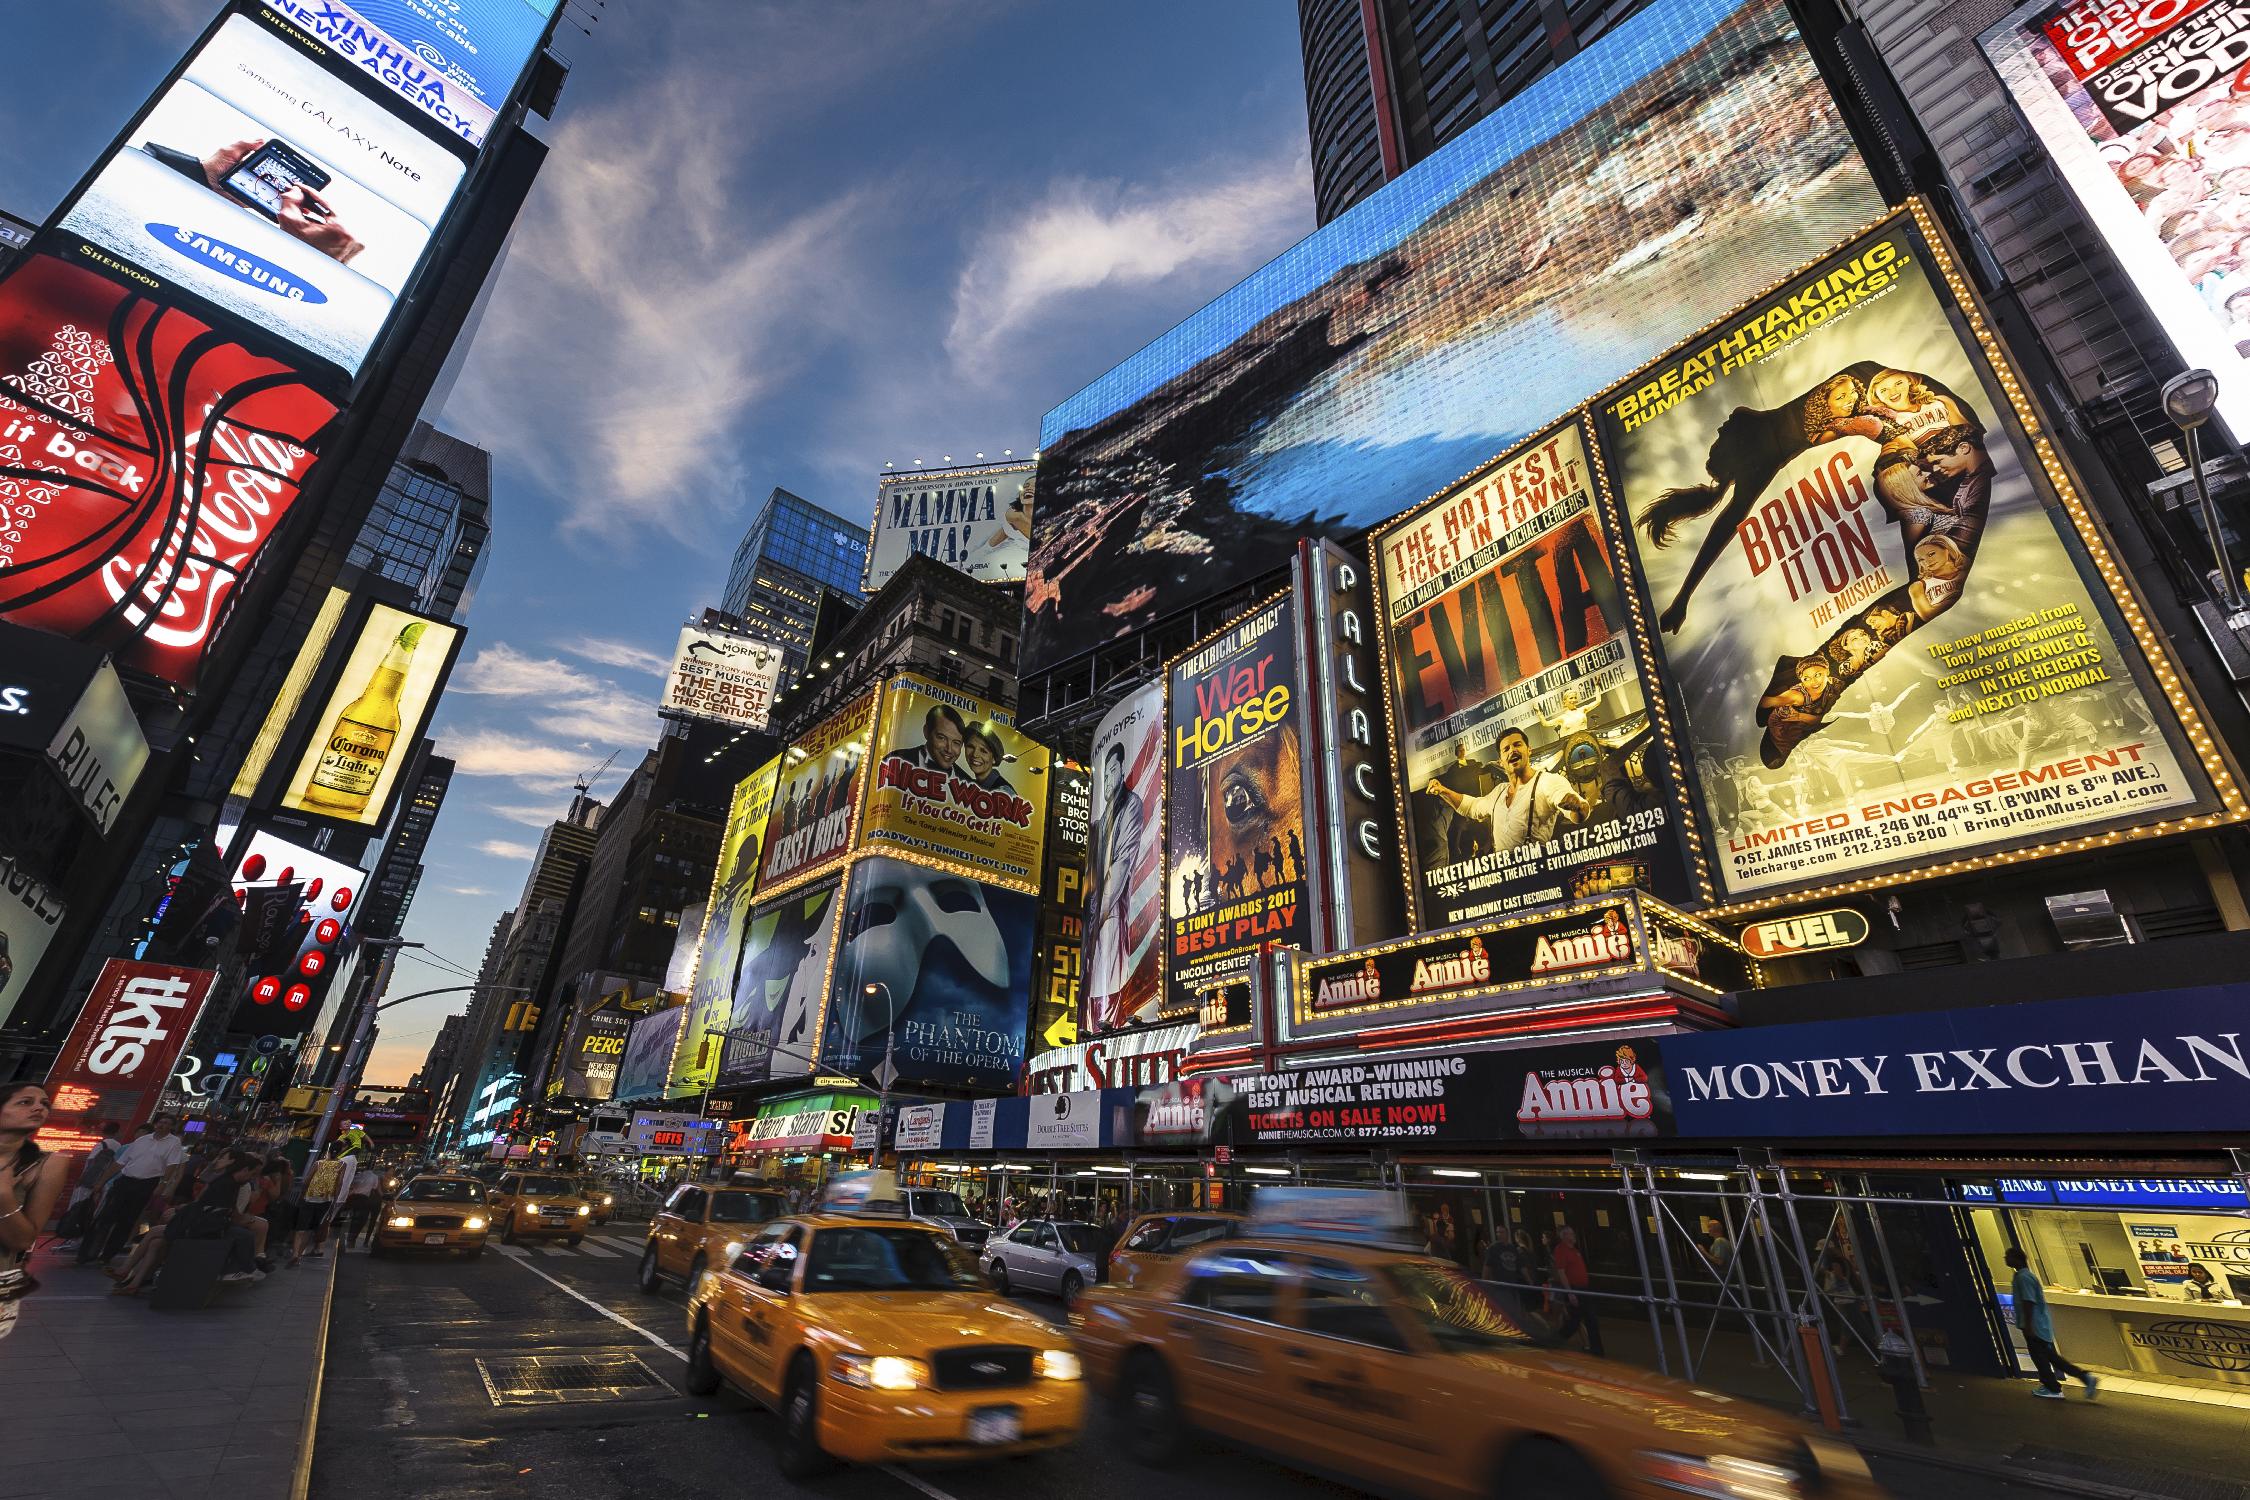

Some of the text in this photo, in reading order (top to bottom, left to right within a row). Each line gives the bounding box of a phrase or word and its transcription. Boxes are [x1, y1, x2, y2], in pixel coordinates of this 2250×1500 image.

[260, 9, 326, 56] SHERWOOD
[314, 1, 446, 103] XINHUA
[435, 20, 478, 55] Cable
[270, 0, 472, 134] NEWS AGENCY
[2095, 28, 2188, 90] DESERVE
[237, 63, 422, 183] Samsung GALAXY Note
[79, 245, 160, 289] SHERWOOD
[174, 227, 305, 302] SAMSUNG
[1758, 284, 1897, 366] THE NEW YORK TIMES
[1624, 372, 1715, 433] HUMAN
[46, 432, 144, 493] back
[886, 486, 996, 529] MAMMA
[893, 482, 948, 494] BENNY ANDERSSON
[1442, 438, 1560, 540] HOTTEST
[1737, 450, 1869, 578] BRING
[906, 525, 972, 565] MIA!
[1396, 540, 1461, 593] TICKET
[1393, 572, 1445, 618] RICKY MARTIN
[1809, 567, 1893, 629] THE MUSICAL
[1393, 511, 1622, 731] EVITA
[1928, 602, 2078, 658] The new musical from
[680, 662, 769, 690] BEST MUSICAL
[682, 656, 740, 674] WINNER TONY
[1937, 637, 2074, 689] creators AVENUE
[1942, 652, 1974, 669] Tony
[2001, 648, 2102, 689] THE HEIGHTS
[672, 694, 700, 708] THIS
[673, 685, 740, 708] MUSICAL
[719, 681, 767, 702] BEST
[924, 684, 978, 714] BRODERICK
[1195, 652, 1274, 721] War
[1433, 641, 1623, 742] TIM RICE ANDREW LLOYD WEBBER
[1949, 666, 2111, 724] and NEXT NORMAL
[820, 694, 874, 735] CROWD
[1113, 704, 1145, 737] GYPSY.
[1176, 684, 1290, 769] Horse
[1335, 561, 1382, 861] PALACE
[330, 735, 385, 760] Corona
[333, 755, 368, 774] Light
[877, 757, 1035, 830] NICE WORK
[901, 793, 915, 811] If
[916, 799, 940, 819] You
[941, 805, 966, 824] Can
[967, 814, 989, 831] Get
[990, 820, 1003, 837] It
[1729, 812, 1850, 853] LIMITED
[1862, 743, 2145, 822] ENGAGEMENT
[766, 822, 816, 880] JERSEY
[812, 804, 852, 860] BOYS
[1425, 807, 1666, 888] TICKETMASTER.COM 877-250-2929
[1736, 849, 1838, 880] Telecharge.com
[1843, 825, 1947, 857] 212.239.6200
[1964, 781, 2168, 834] BringItOnMusical.com
[1747, 799, 1998, 865] ST. JAMES 246 ST.
[930, 841, 1029, 877] FUNNIEST LOVE STORY
[1467, 830, 1658, 892] MARQUIS THEATRE EVITAONBROADWAY.COM
[1176, 888, 1296, 935] 5 TONY 2011
[1448, 886, 1563, 923] NEW BROADWAY CAST RECORDING
[1176, 923, 1231, 956] BEST
[1235, 904, 1297, 940] PLAY
[1530, 925, 1631, 975] Annie
[1757, 912, 1852, 955] FUEL
[1175, 962, 1213, 982] LINCOLN
[1183, 979, 1199, 990] TAKE
[1315, 971, 1381, 1008] Annie
[1410, 950, 1492, 994] Annie
[88, 976, 192, 1076] tkts
[591, 1014, 612, 1024] CRIME
[904, 1020, 1020, 1058] PHANTOM
[953, 1010, 981, 1027] THE
[588, 1062, 602, 1071] NEW
[936, 1051, 1010, 1071] THE OPERA
[1231, 1072, 1300, 1094] THE TONY
[1540, 1067, 1595, 1079] THE MUSICAL
[1682, 1054, 1889, 1103] MONEY
[1248, 1079, 1445, 1109] BEST MUSICAL RETURNS
[1517, 1065, 1653, 1123] Annie
[654, 1132, 684, 1145] GIFTS
[752, 1112, 786, 1140] sbarro
[787, 1106, 826, 1137] sbarro
[1248, 1104, 1447, 1130] TICKETS SALE NOW!
[1257, 1125, 1437, 1141] ANNIETHEMUSICAL.COM OR 877-250-2929
[2186, 1244, 2229, 1260] THE
[2130, 1332, 2196, 1350] MONEY
